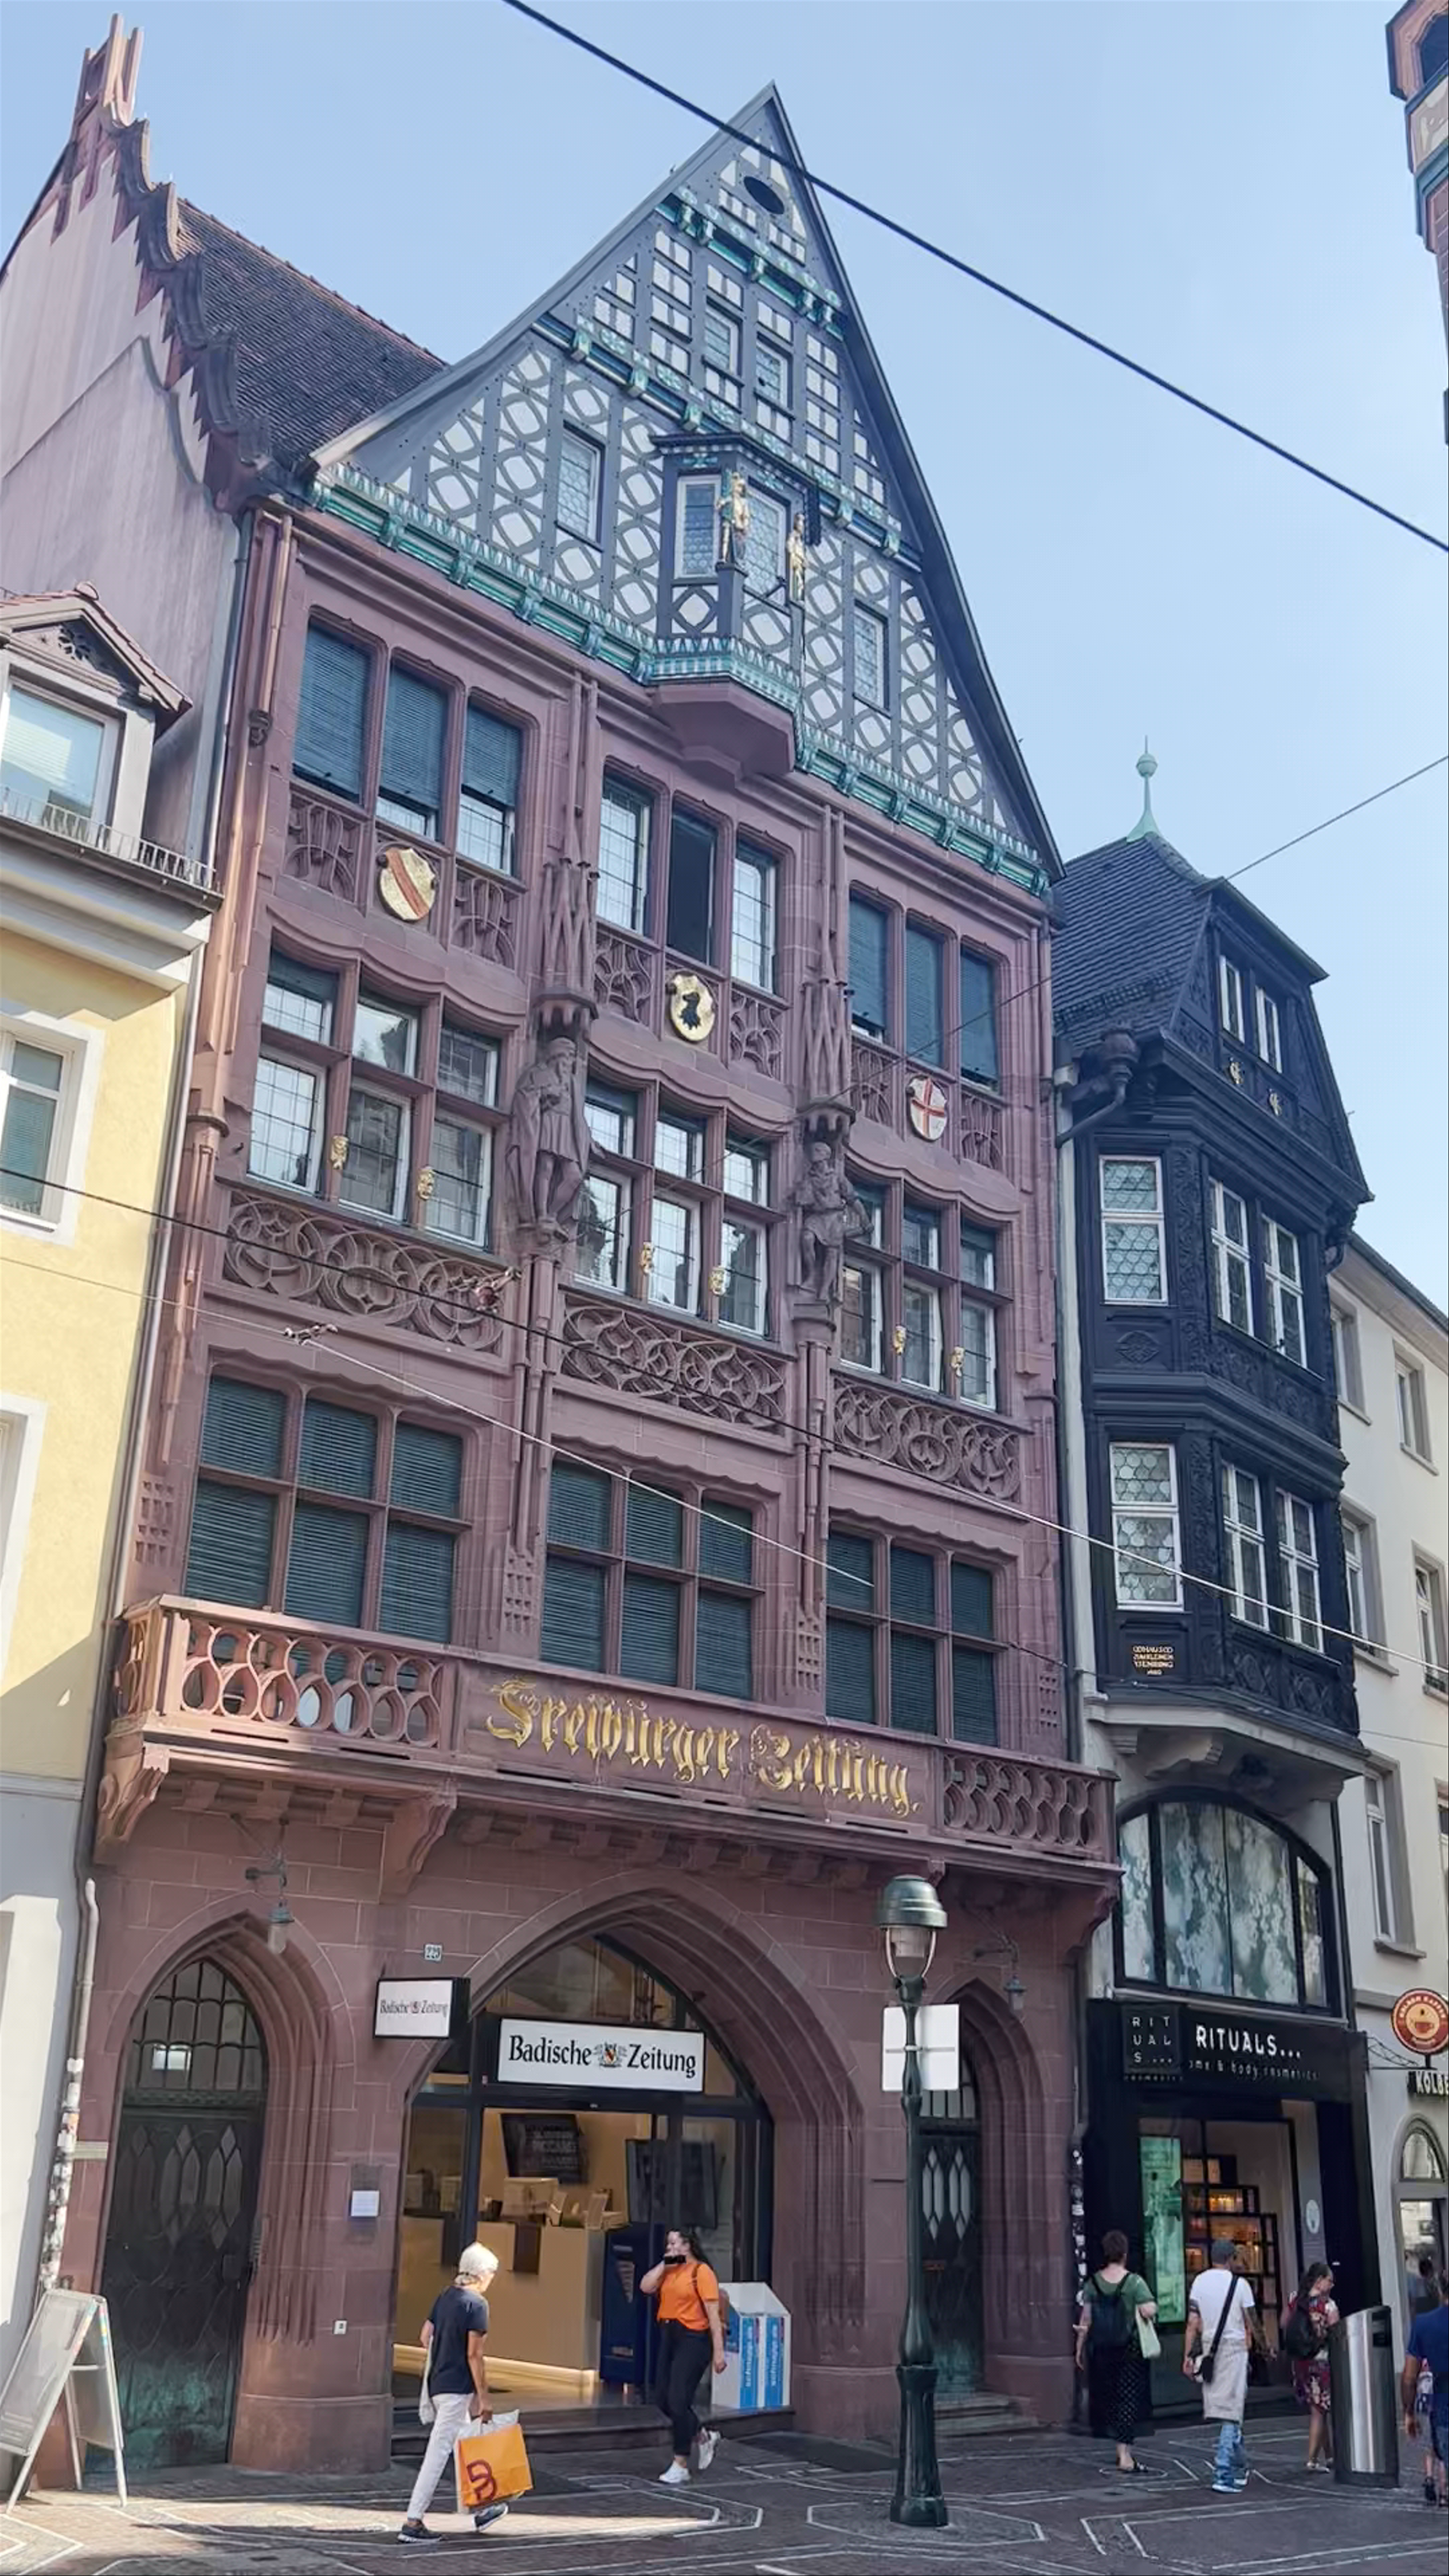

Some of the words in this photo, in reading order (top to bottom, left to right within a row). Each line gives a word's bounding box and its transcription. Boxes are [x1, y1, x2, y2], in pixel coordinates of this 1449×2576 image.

[380, 2000, 408, 2014] Badische
[421, 1999, 448, 2018] Zeitung
[508, 2035, 592, 2066] Badische
[627, 2044, 696, 2078] Zeitung
